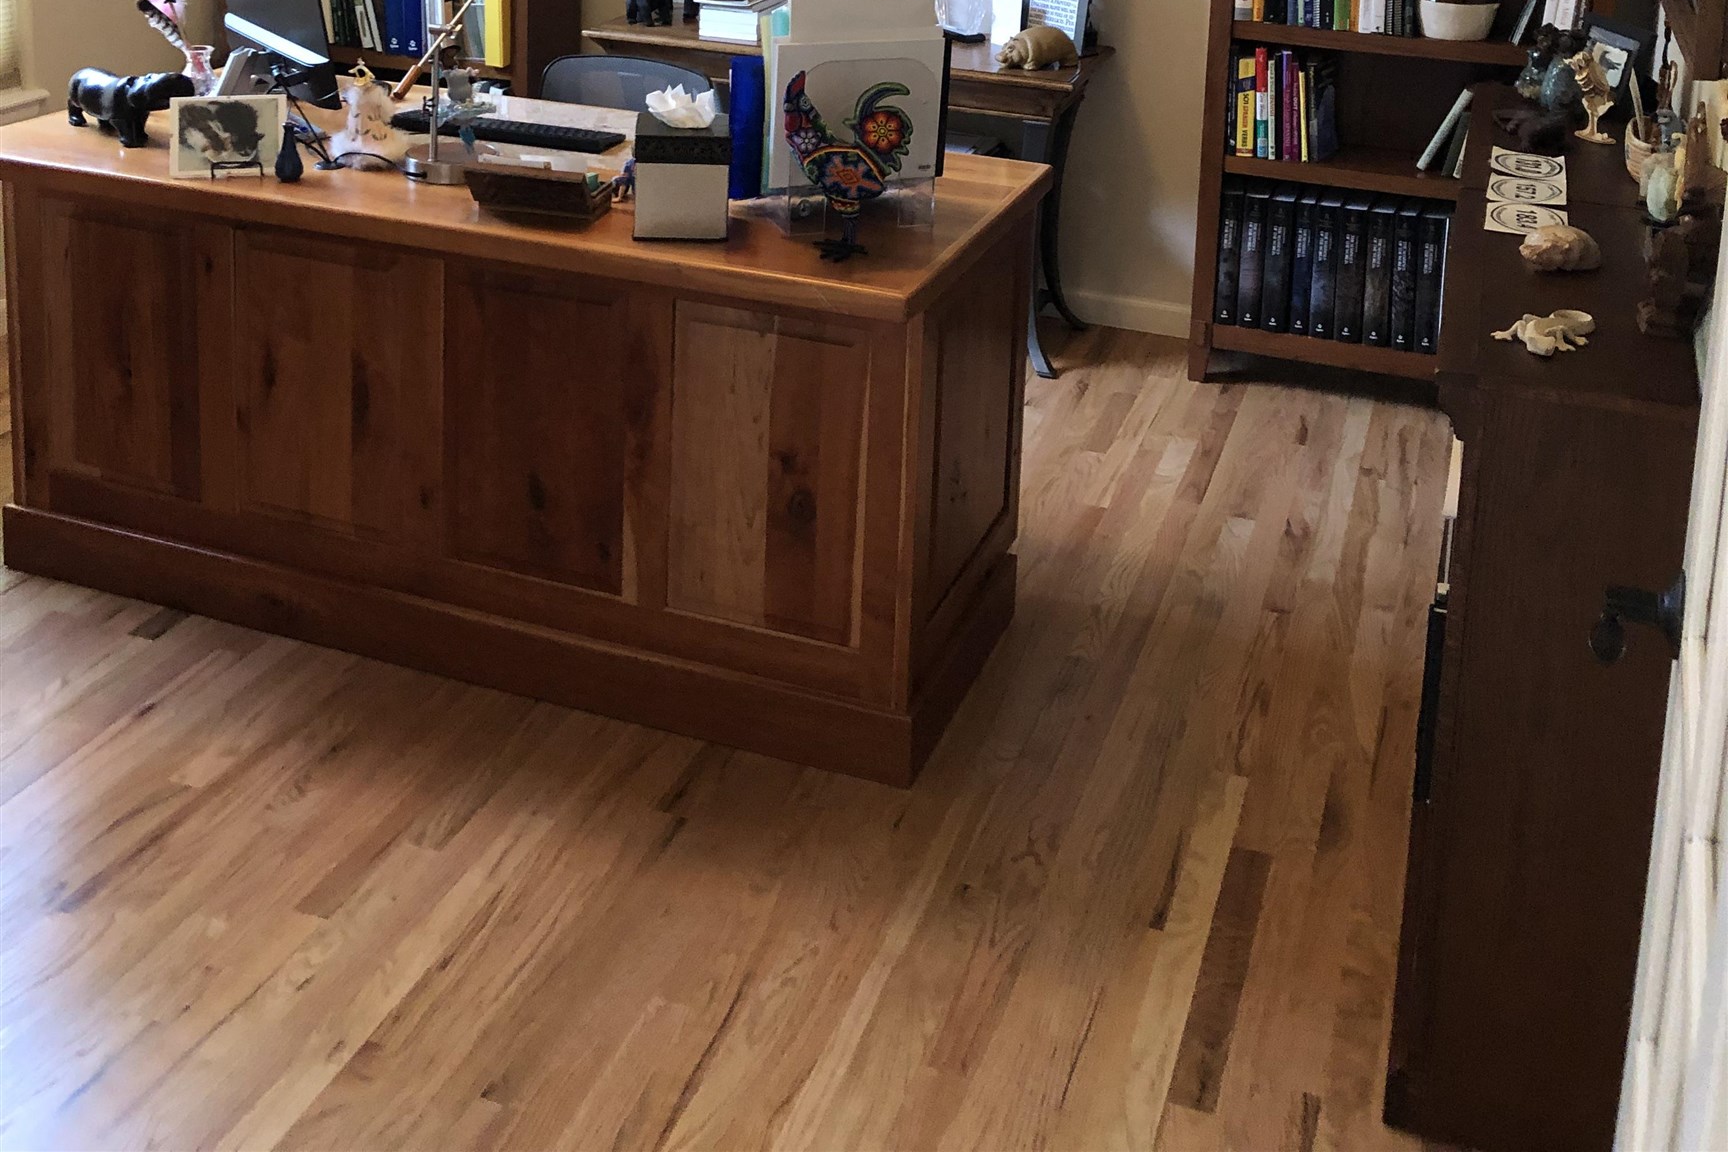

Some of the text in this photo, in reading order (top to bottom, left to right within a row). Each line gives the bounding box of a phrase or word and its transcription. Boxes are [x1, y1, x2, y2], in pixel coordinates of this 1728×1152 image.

[1242, 93, 1251, 104] 501
[1241, 129, 1251, 148] VERBS
[1514, 183, 1537, 199] 157.2
[1516, 210, 1538, 230] 183.4
